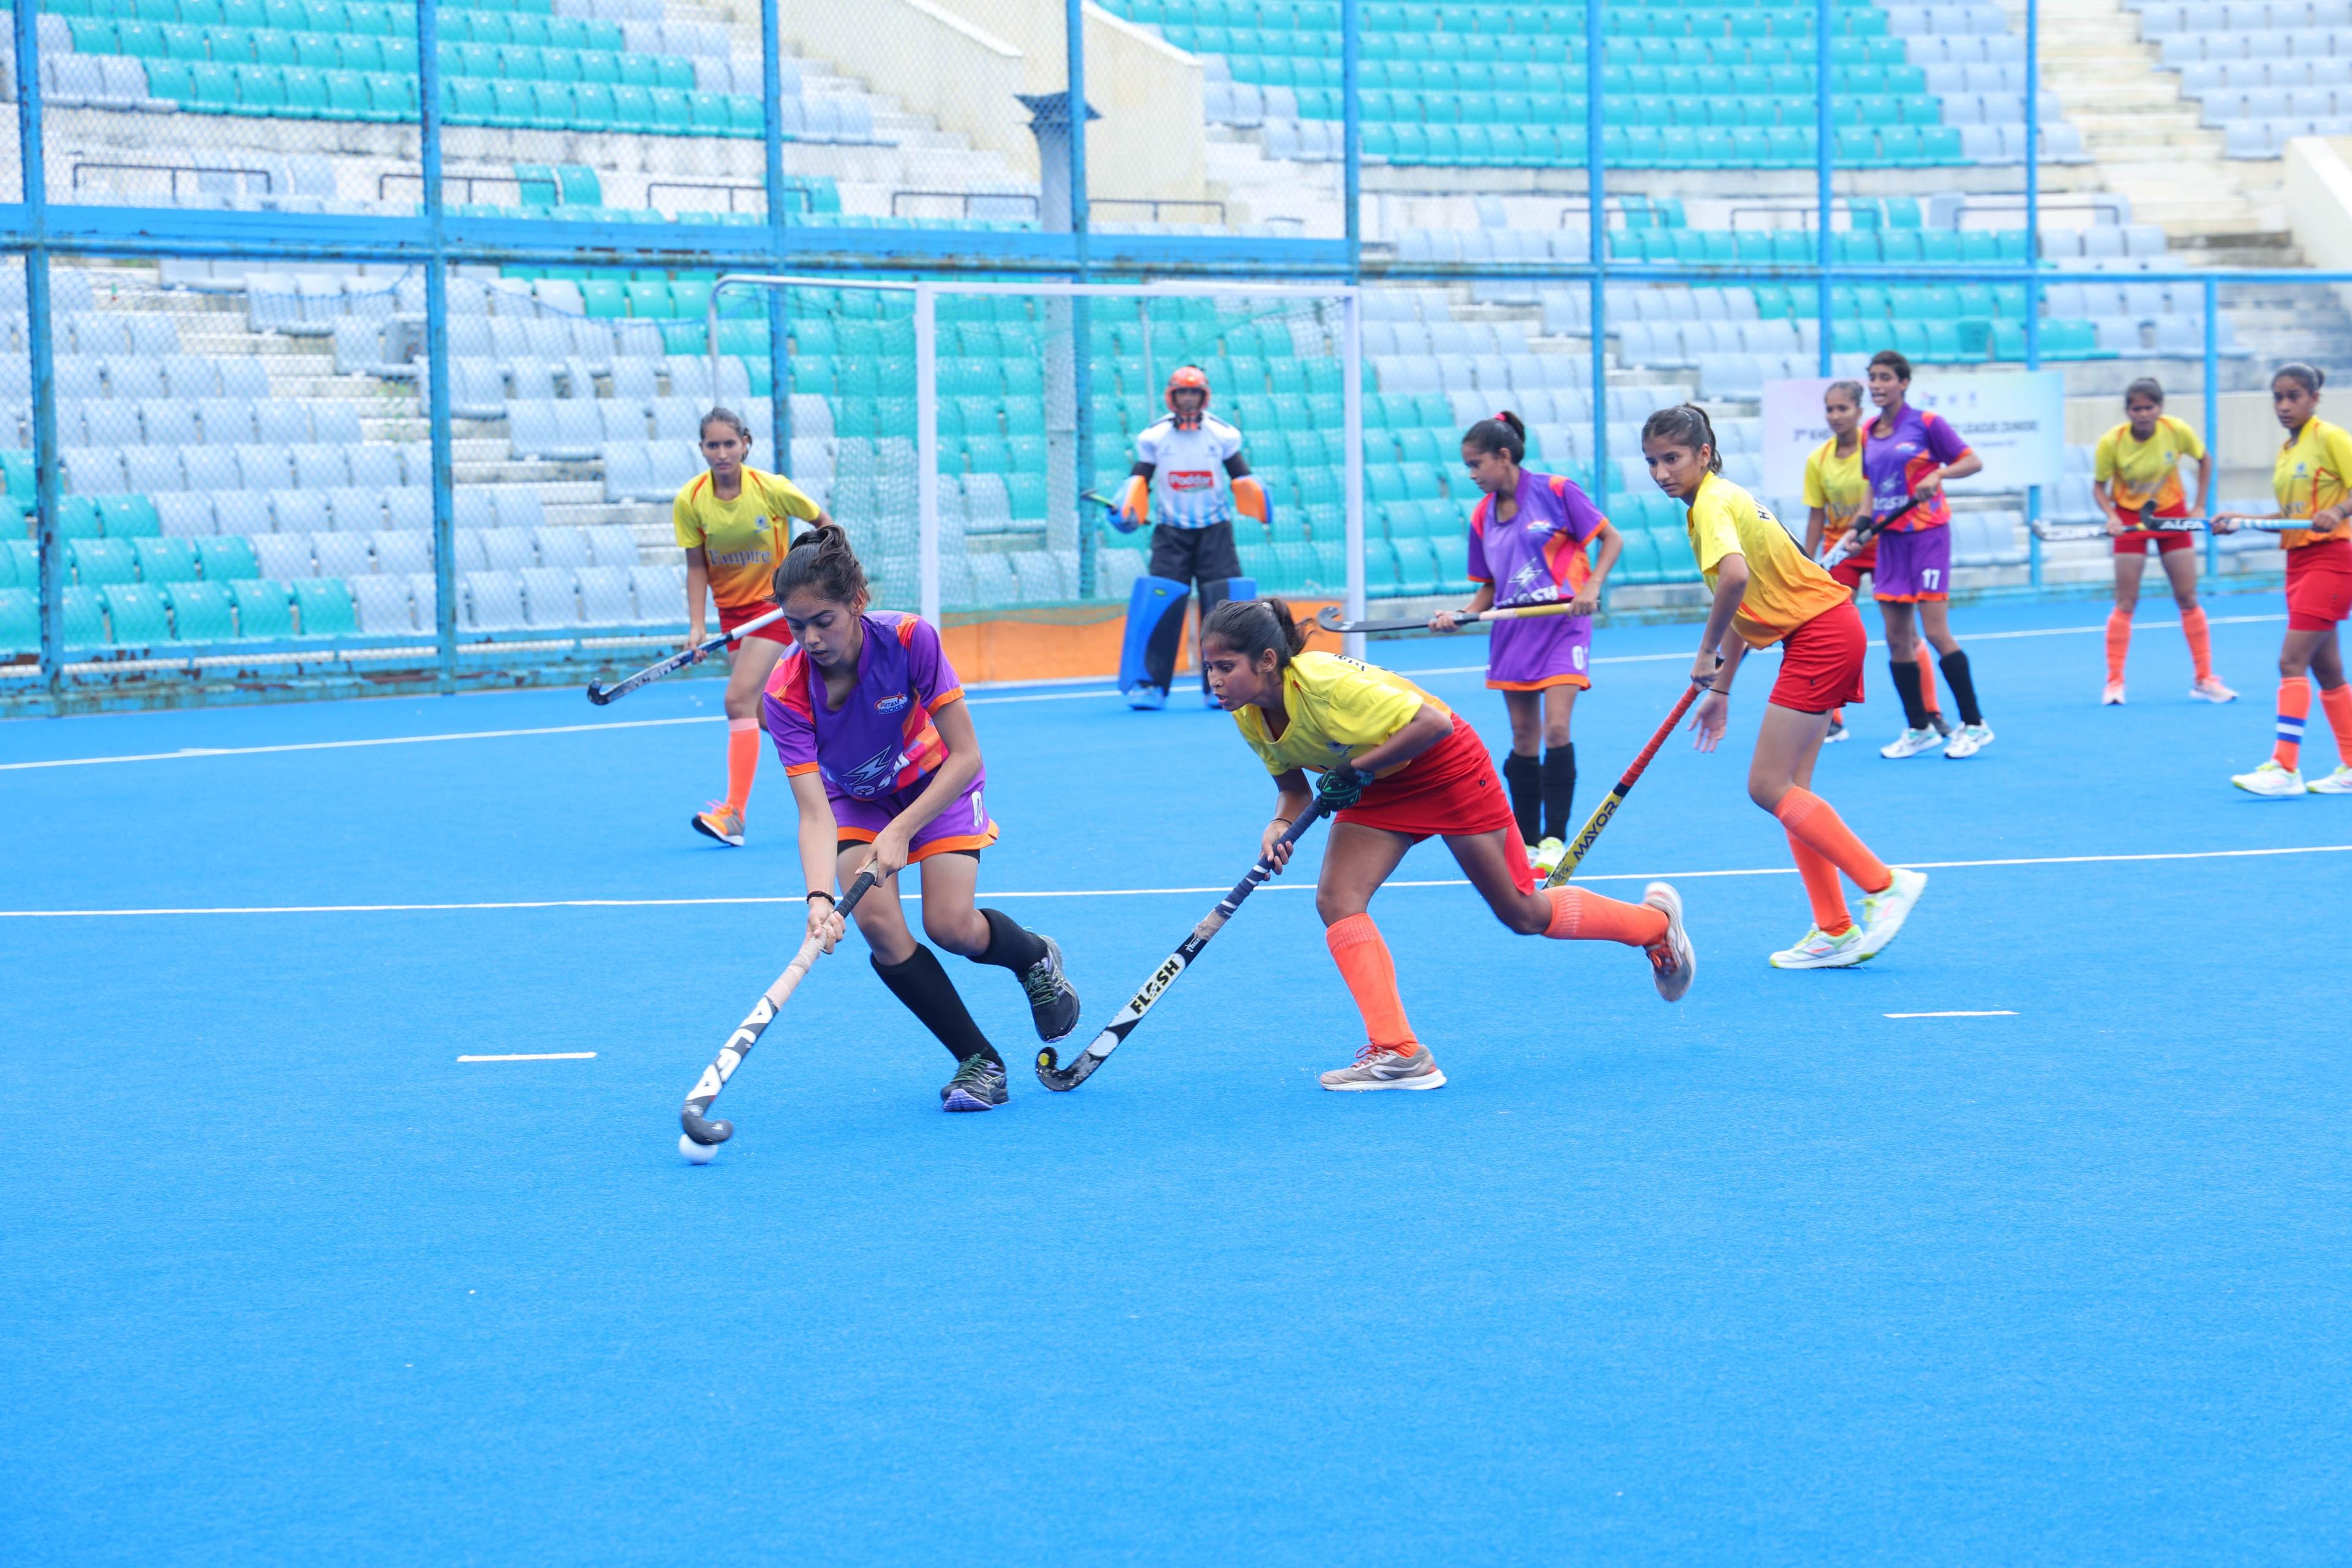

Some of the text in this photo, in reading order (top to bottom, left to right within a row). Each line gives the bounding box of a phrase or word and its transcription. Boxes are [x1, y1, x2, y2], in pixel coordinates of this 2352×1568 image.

[2159, 519, 2205, 531] ALFA
[1921, 568, 1940, 590] 17
[880, 703, 906, 714] HOCKEY
[1573, 801, 1618, 861] MAYOR
[1130, 959, 1180, 1015] FLASH
[685, 995, 774, 1101] ALFA
